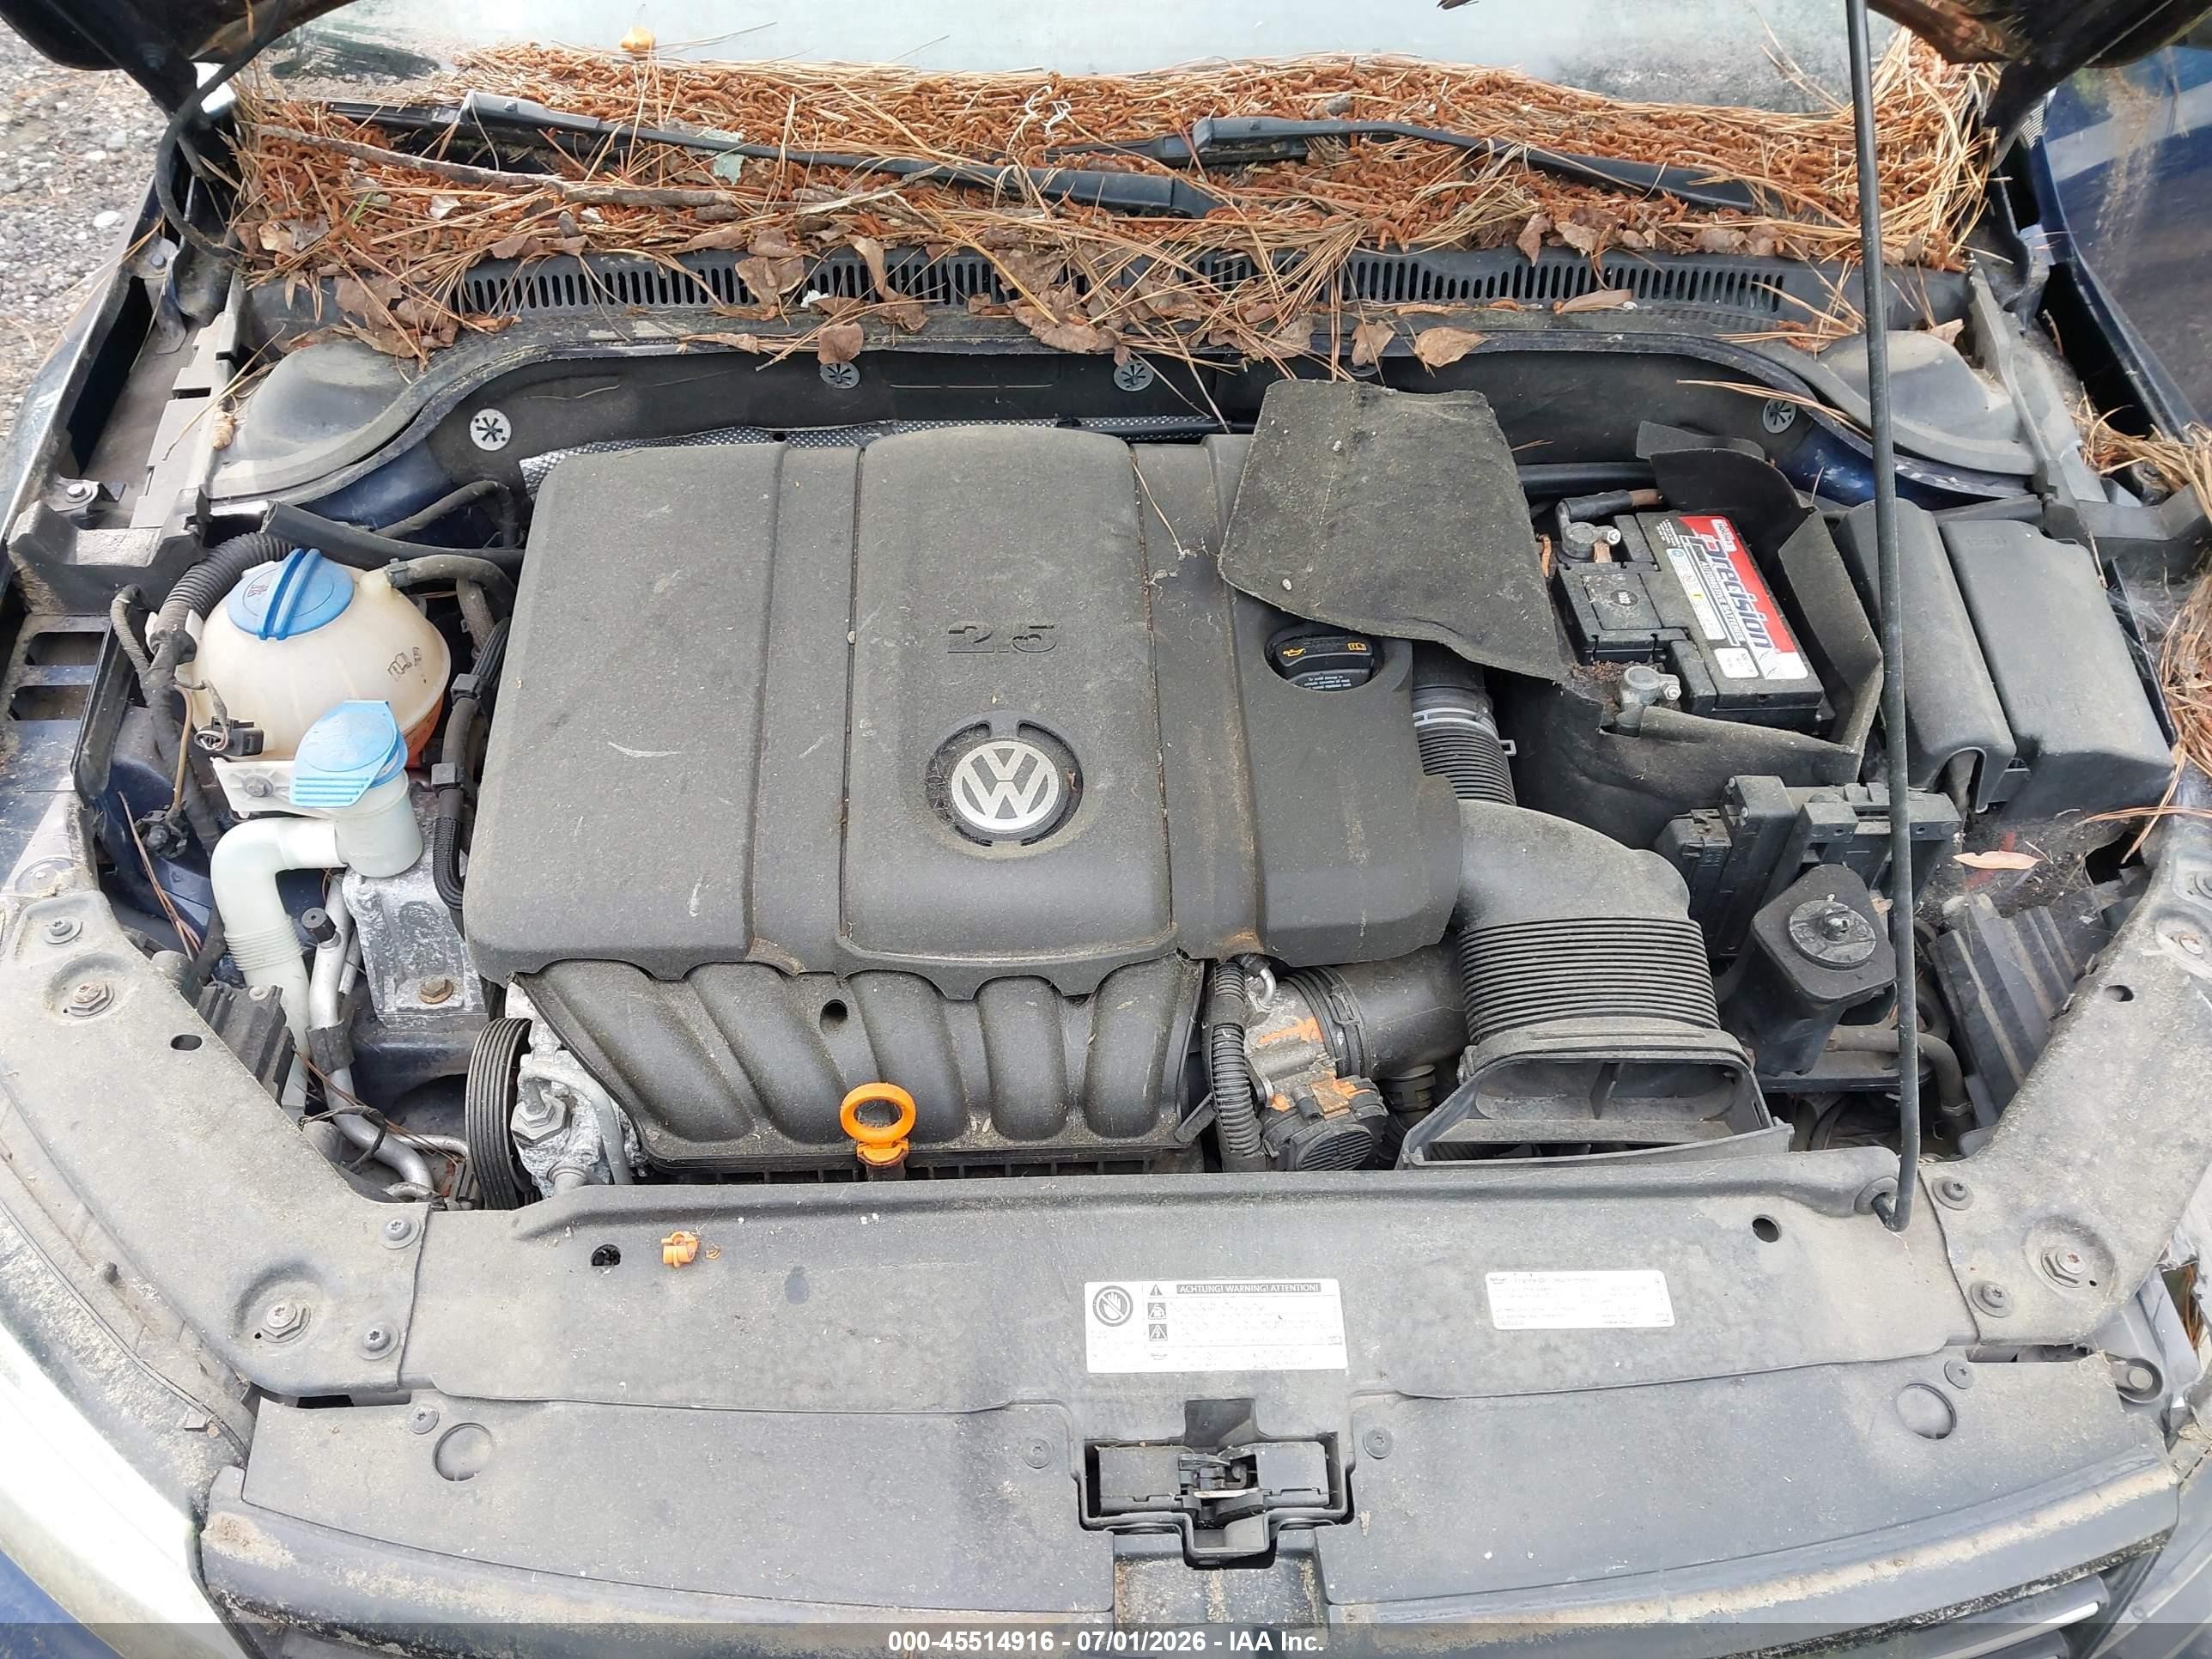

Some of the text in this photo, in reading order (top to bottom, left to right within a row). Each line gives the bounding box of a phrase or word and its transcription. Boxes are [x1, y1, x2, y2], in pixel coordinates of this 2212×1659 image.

[1680, 533, 1774, 650] Precision
[1700, 560, 1728, 605] AUTOMOTIVE
[1720, 604, 1747, 642] BATTERIES
[947, 624, 1058, 653] 2.5
[1179, 1283, 1319, 1294] ACHTUNG! WARNING! ATTENTION!
